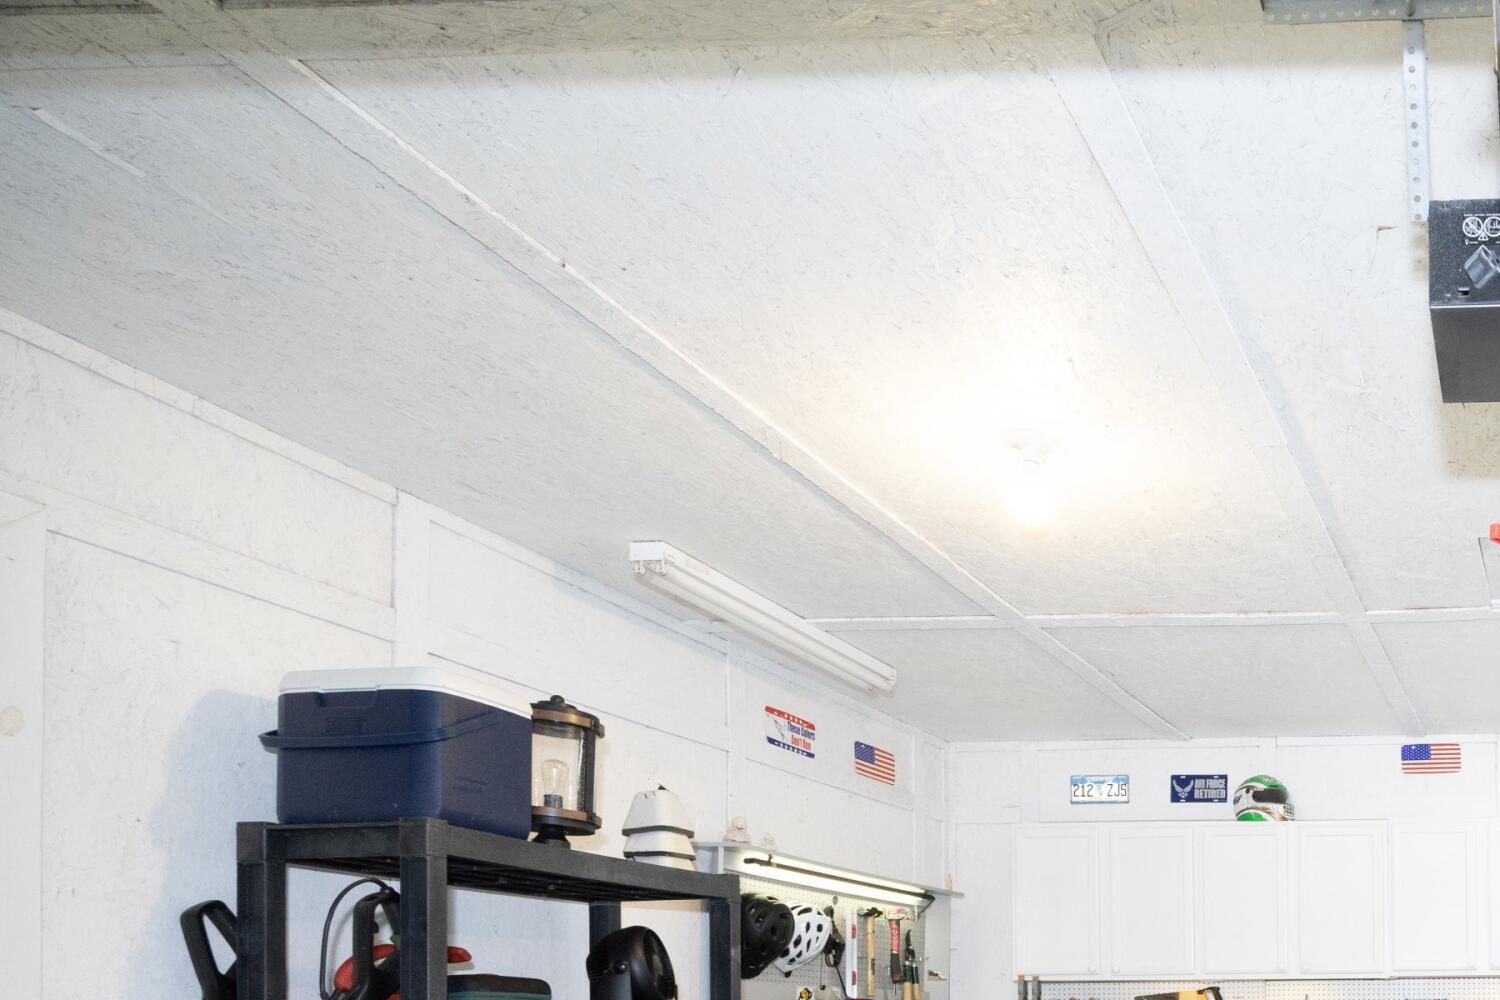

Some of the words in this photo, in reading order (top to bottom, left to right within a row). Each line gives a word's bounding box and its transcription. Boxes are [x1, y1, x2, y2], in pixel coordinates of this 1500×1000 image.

[788, 721, 801, 736] These
[1194, 778, 1206, 789] AIR
[1206, 778, 1226, 789] FORCE
[1073, 783, 1094, 798] 212
[1193, 788, 1226, 799] RETIRED
